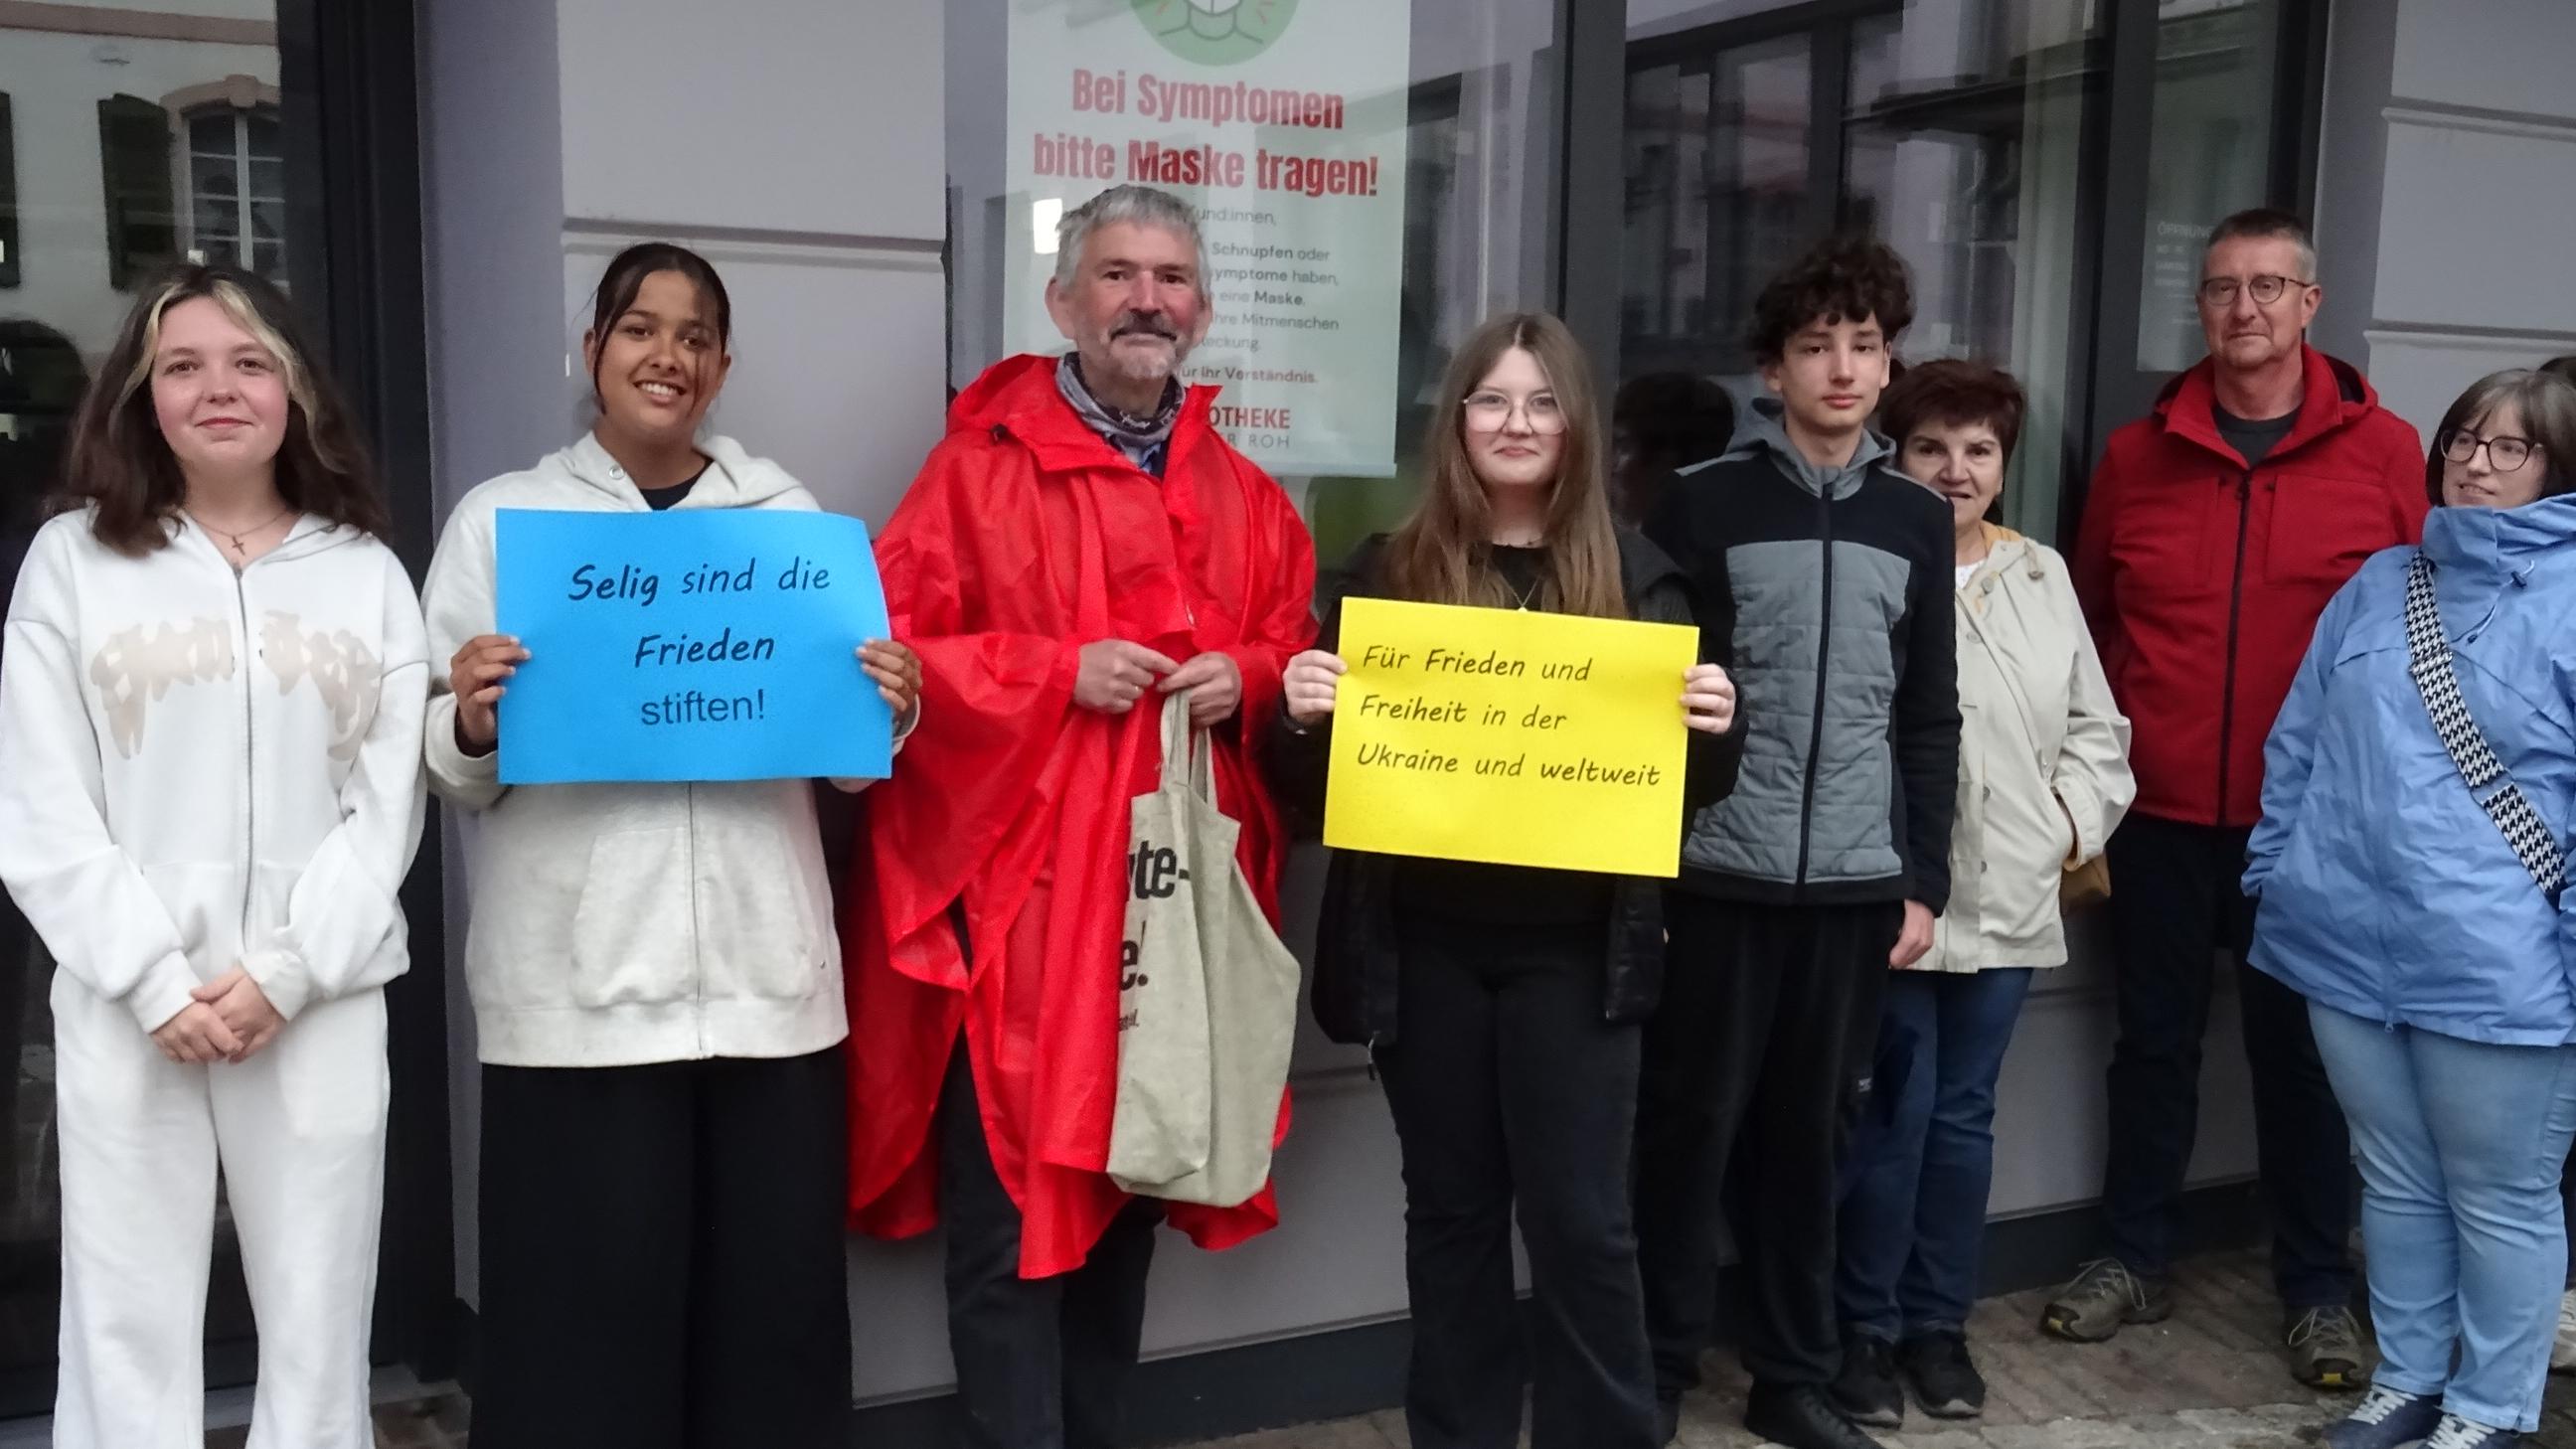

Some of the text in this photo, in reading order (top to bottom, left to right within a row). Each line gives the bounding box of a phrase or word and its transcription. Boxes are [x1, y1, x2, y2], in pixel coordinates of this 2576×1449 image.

[1072, 69, 1344, 129] Bei Symptomen
[1034, 132, 1378, 198] bitte Maske tragen!
[1195, 207, 1277, 227] und:innen,
[1211, 242, 1331, 261] Schnupfen oder
[1214, 268, 1339, 285] ymptome haben,
[1214, 313, 1340, 331] hre Mitmenschen
[1202, 366, 1220, 379] Ihr
[1208, 406, 1291, 429] OTHEKE
[1248, 433, 1290, 449] ROH
[567, 556, 831, 606] Selig sind die
[634, 627, 775, 668] Frieden
[1363, 644, 1593, 681] Für Frieden und
[641, 689, 765, 725] stiften!
[1360, 695, 1567, 730] Freiheit in der
[1357, 742, 1662, 786] Ukraine und weltweit
[1128, 840, 1190, 900] te-
